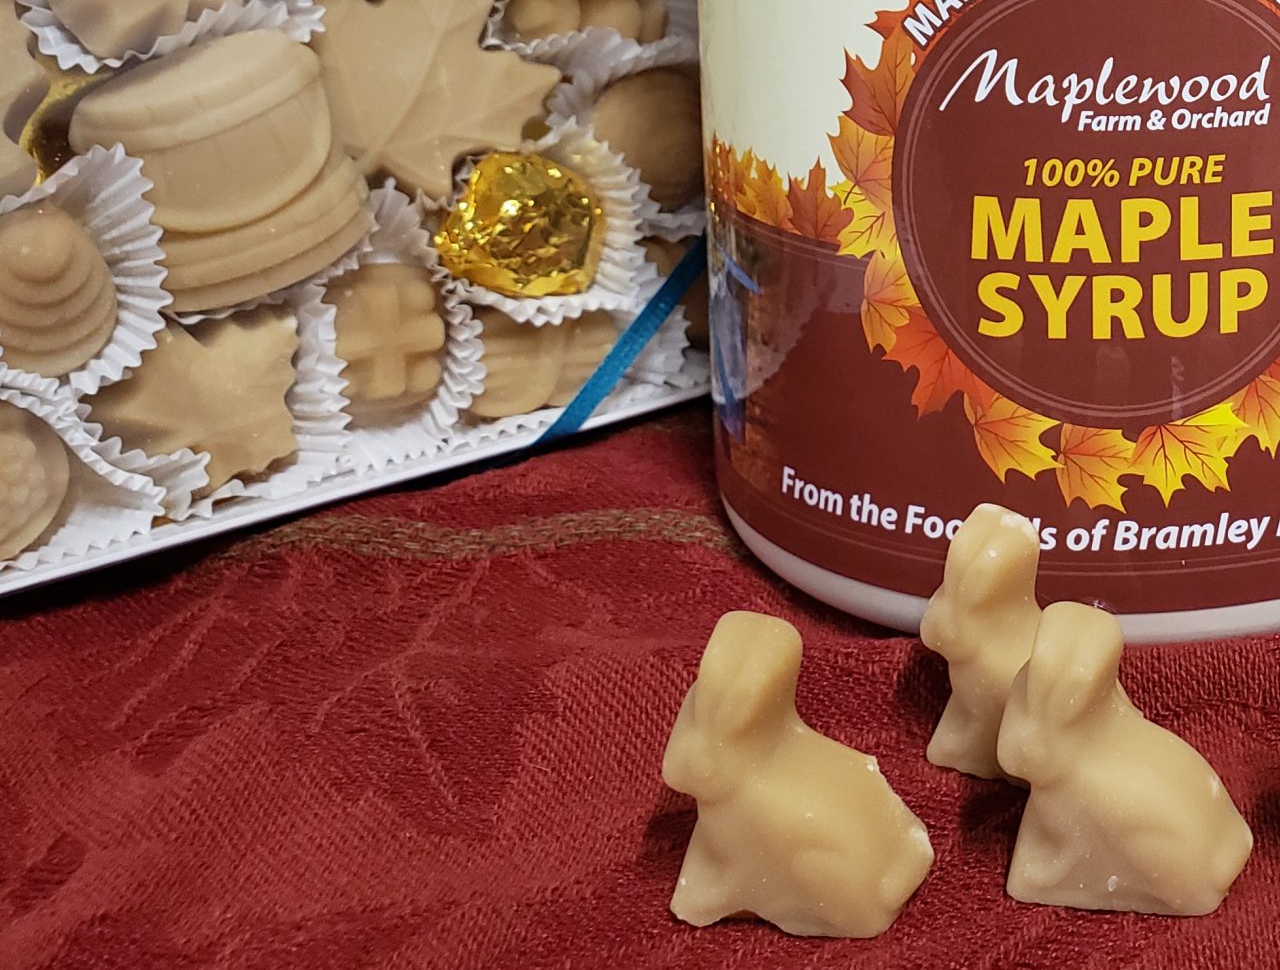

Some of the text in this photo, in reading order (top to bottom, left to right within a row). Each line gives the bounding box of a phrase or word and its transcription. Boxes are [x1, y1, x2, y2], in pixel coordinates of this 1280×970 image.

[939, 48, 1271, 123] Maplewood
[1078, 103, 1271, 131] Farm & Orchard
[1023, 153, 1226, 188] 100% PURE
[971, 190, 1275, 263] MAPLE
[977, 267, 1269, 340] SYRUP
[782, 466, 843, 516] From
[850, 493, 898, 531] the
[904, 504, 1057, 551] Fools
[1066, 518, 1108, 552] of
[1113, 512, 1271, 550] Bramley
